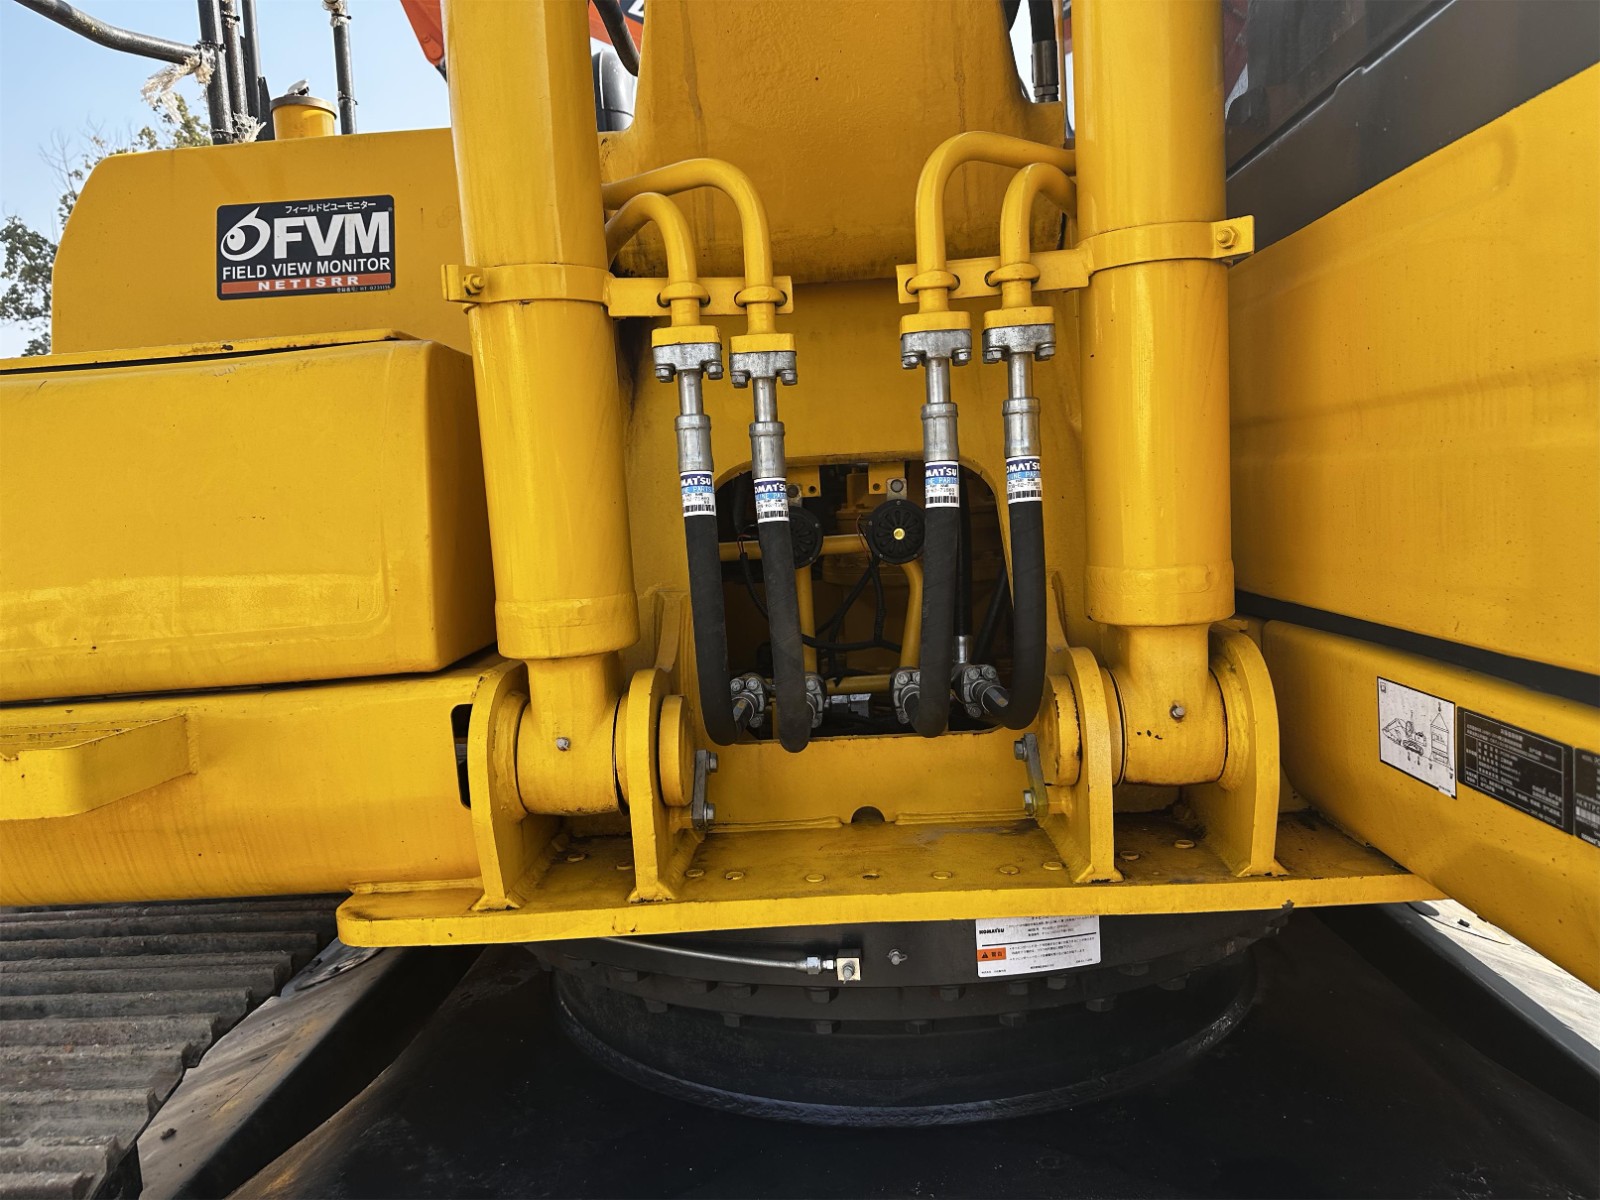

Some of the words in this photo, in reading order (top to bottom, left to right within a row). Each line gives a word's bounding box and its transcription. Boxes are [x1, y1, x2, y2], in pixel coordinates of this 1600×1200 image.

[273, 211, 390, 260] FVM
[222, 264, 267, 280] FIELD
[271, 262, 313, 277] VIEW
[316, 257, 391, 274] MONITOR
